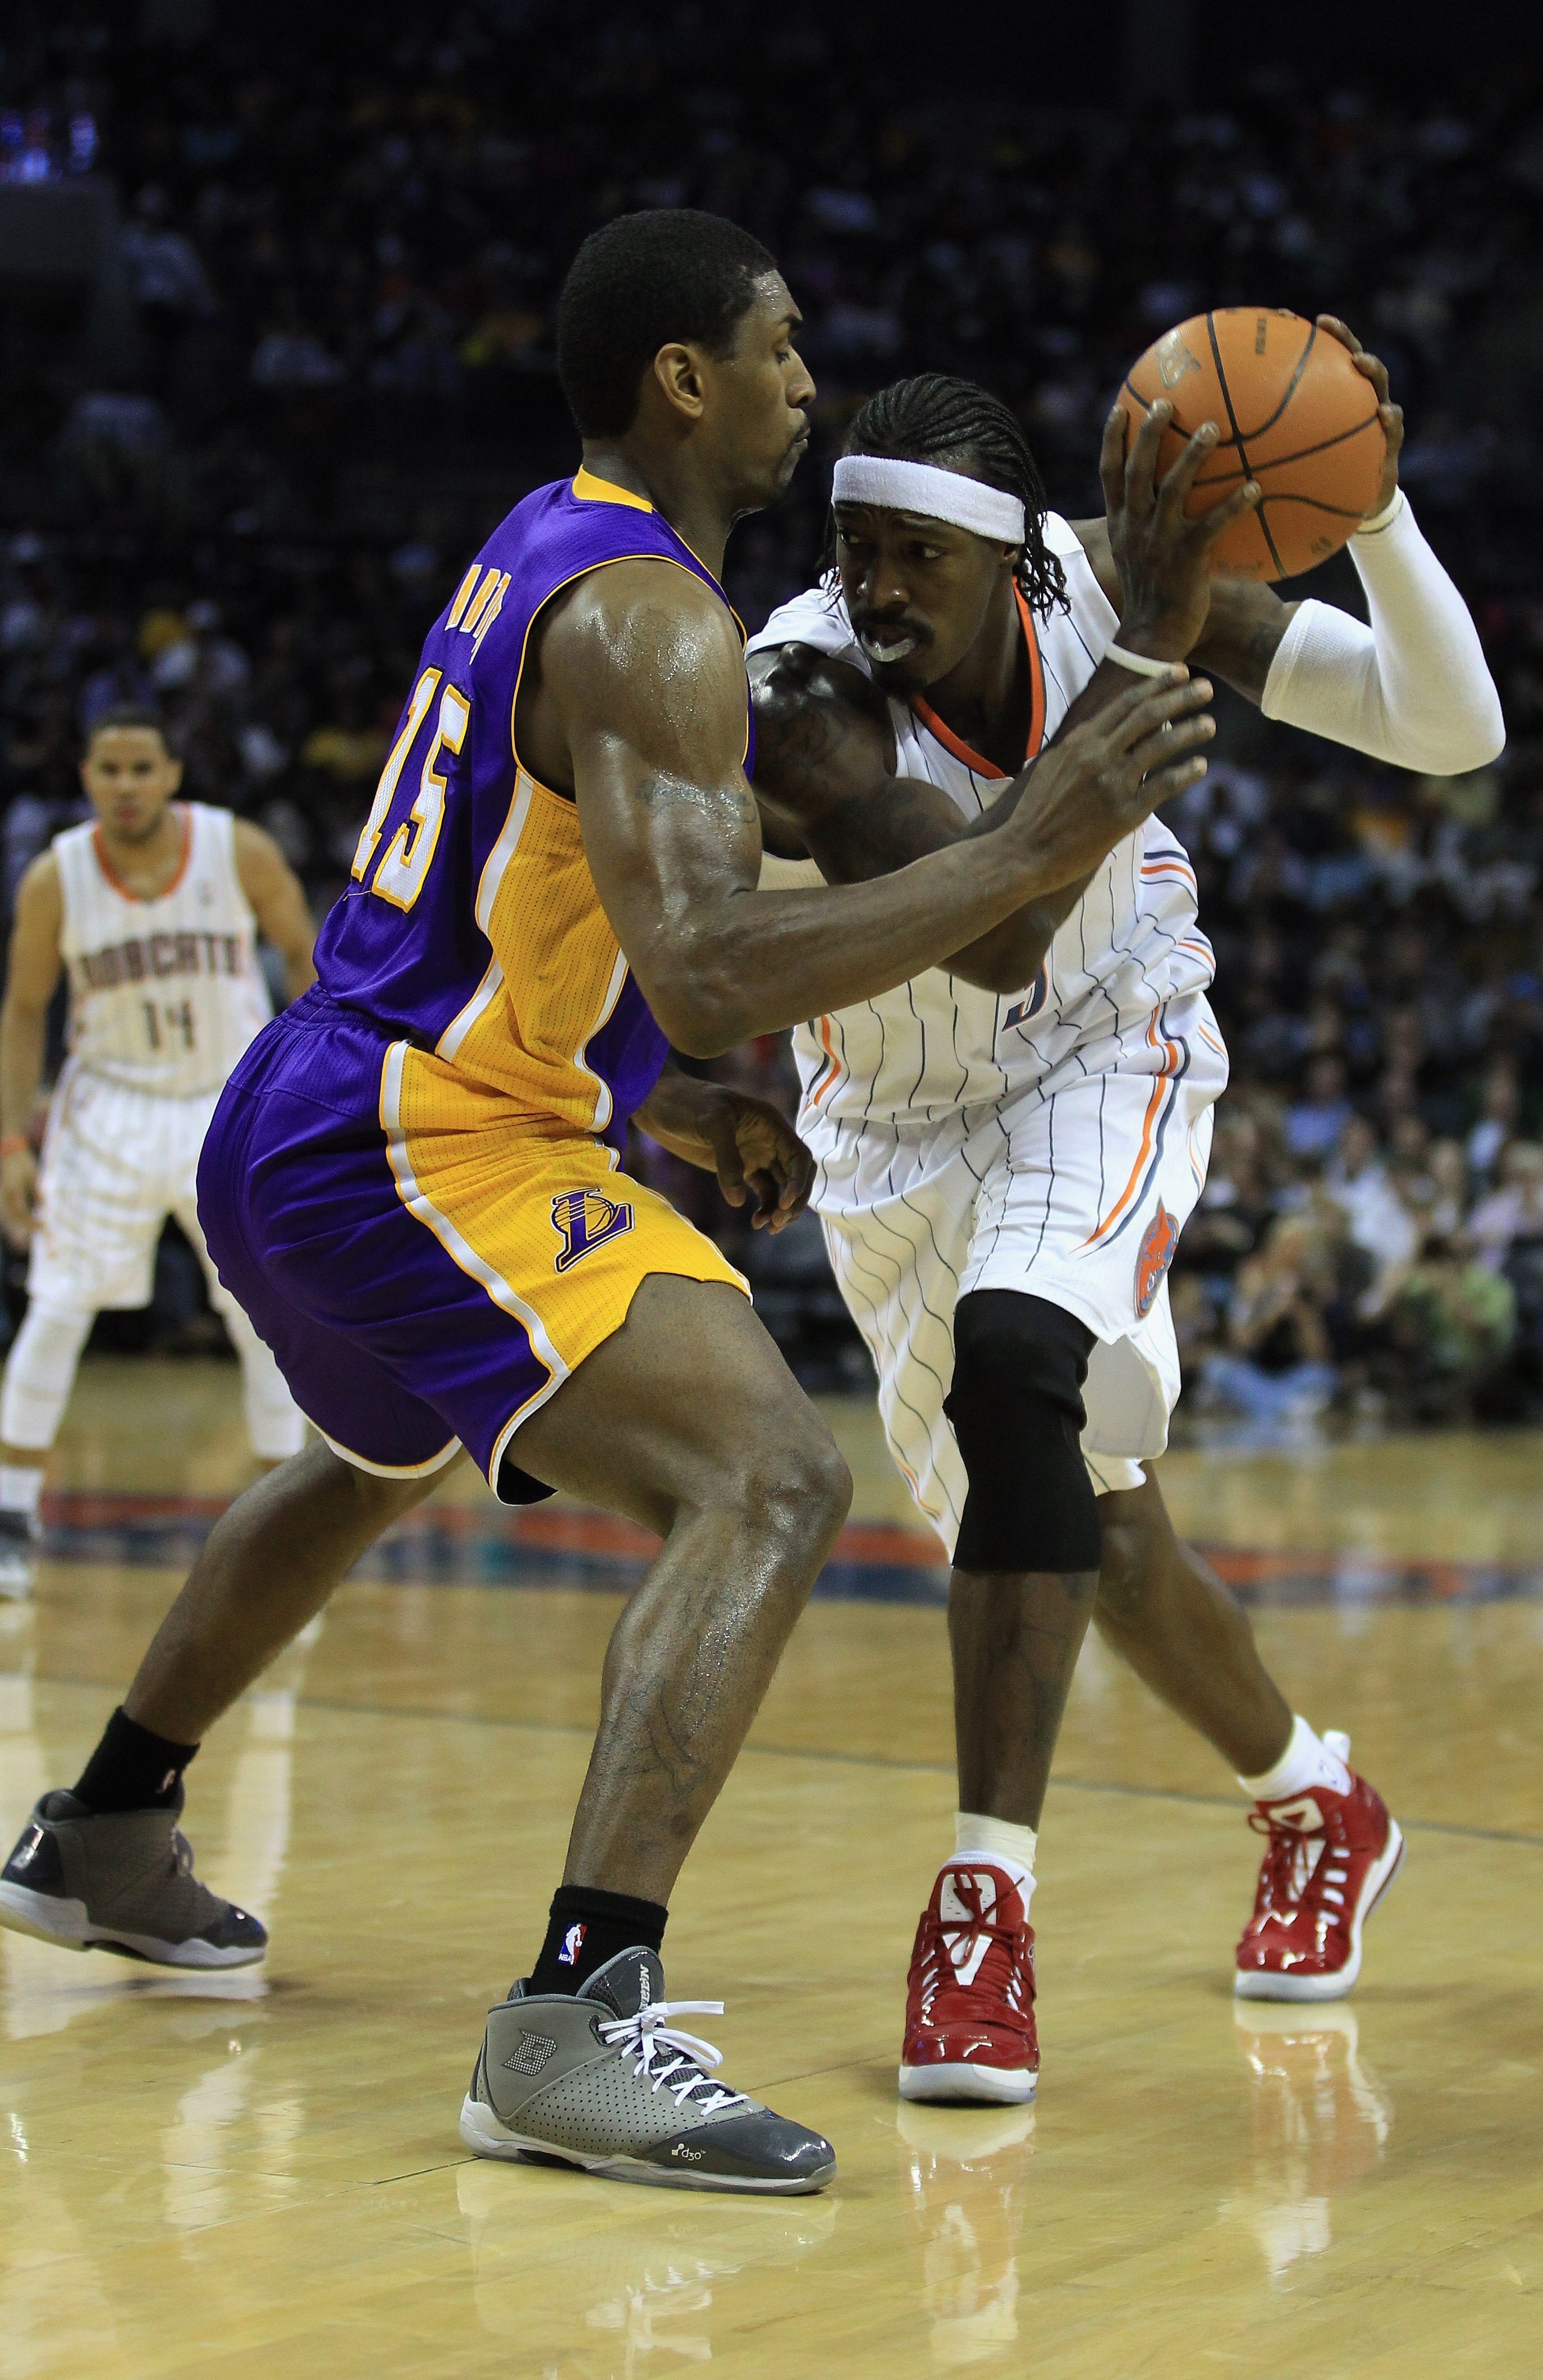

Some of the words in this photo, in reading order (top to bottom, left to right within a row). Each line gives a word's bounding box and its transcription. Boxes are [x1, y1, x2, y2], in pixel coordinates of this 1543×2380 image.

[444, 564, 512, 665] ART
[351, 666, 471, 914] 15
[141, 998, 196, 1051] 14
[558, 1953, 571, 1962] NBA
[501, 2027, 557, 2076] B
